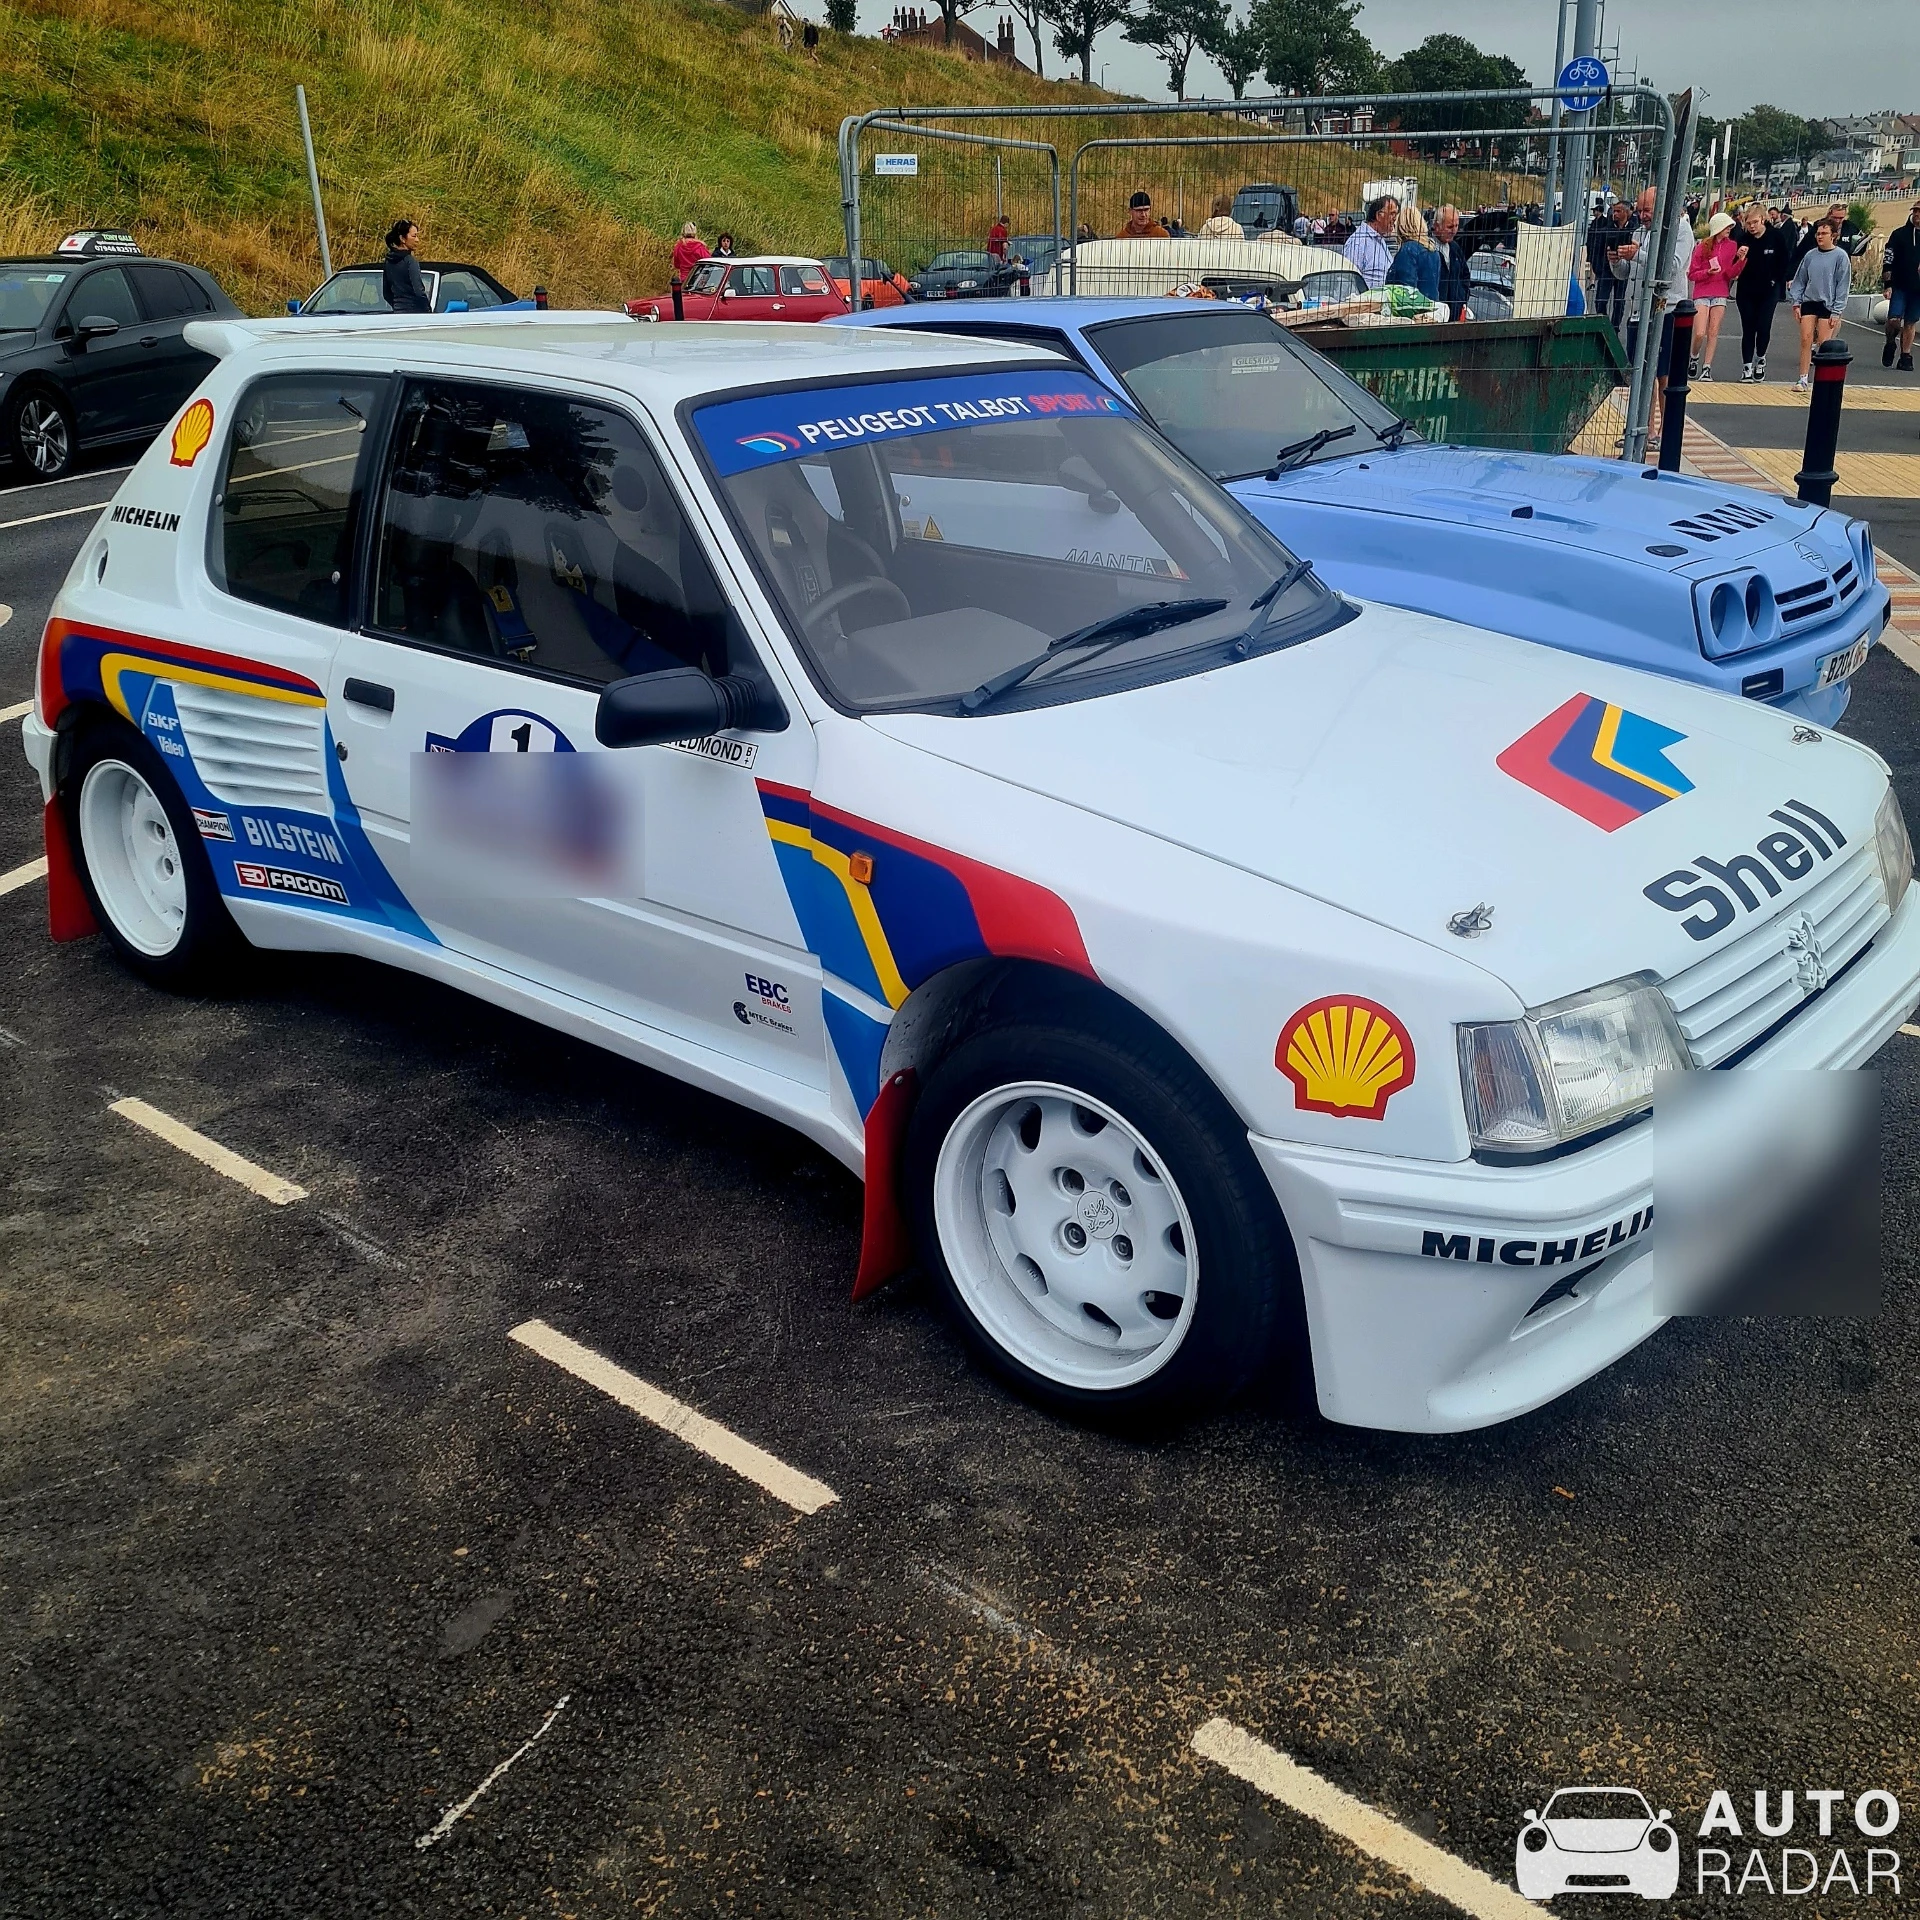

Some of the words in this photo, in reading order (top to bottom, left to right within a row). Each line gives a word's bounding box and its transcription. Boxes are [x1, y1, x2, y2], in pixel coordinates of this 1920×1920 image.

[885, 158, 916, 166] HERAS
[66, 238, 79, 247] L
[797, 405, 937, 444] PEUGEOT
[934, 395, 1032, 422] TALBOT
[1027, 393, 1098, 414] SPORT
[110, 505, 181, 532] MICHELIN
[1064, 548, 1157, 575] MANTA
[147, 711, 179, 731] SKF
[157, 734, 185, 758] Valeo
[511, 722, 531, 752] 1
[668, 737, 743, 761] EDMOND
[241, 816, 344, 865] BILSTEIN
[1642, 799, 1848, 941] Shell
[270, 872, 344, 899] FACOM
[745, 972, 789, 1004] EBC
[761, 997, 792, 1014] BRAKES
